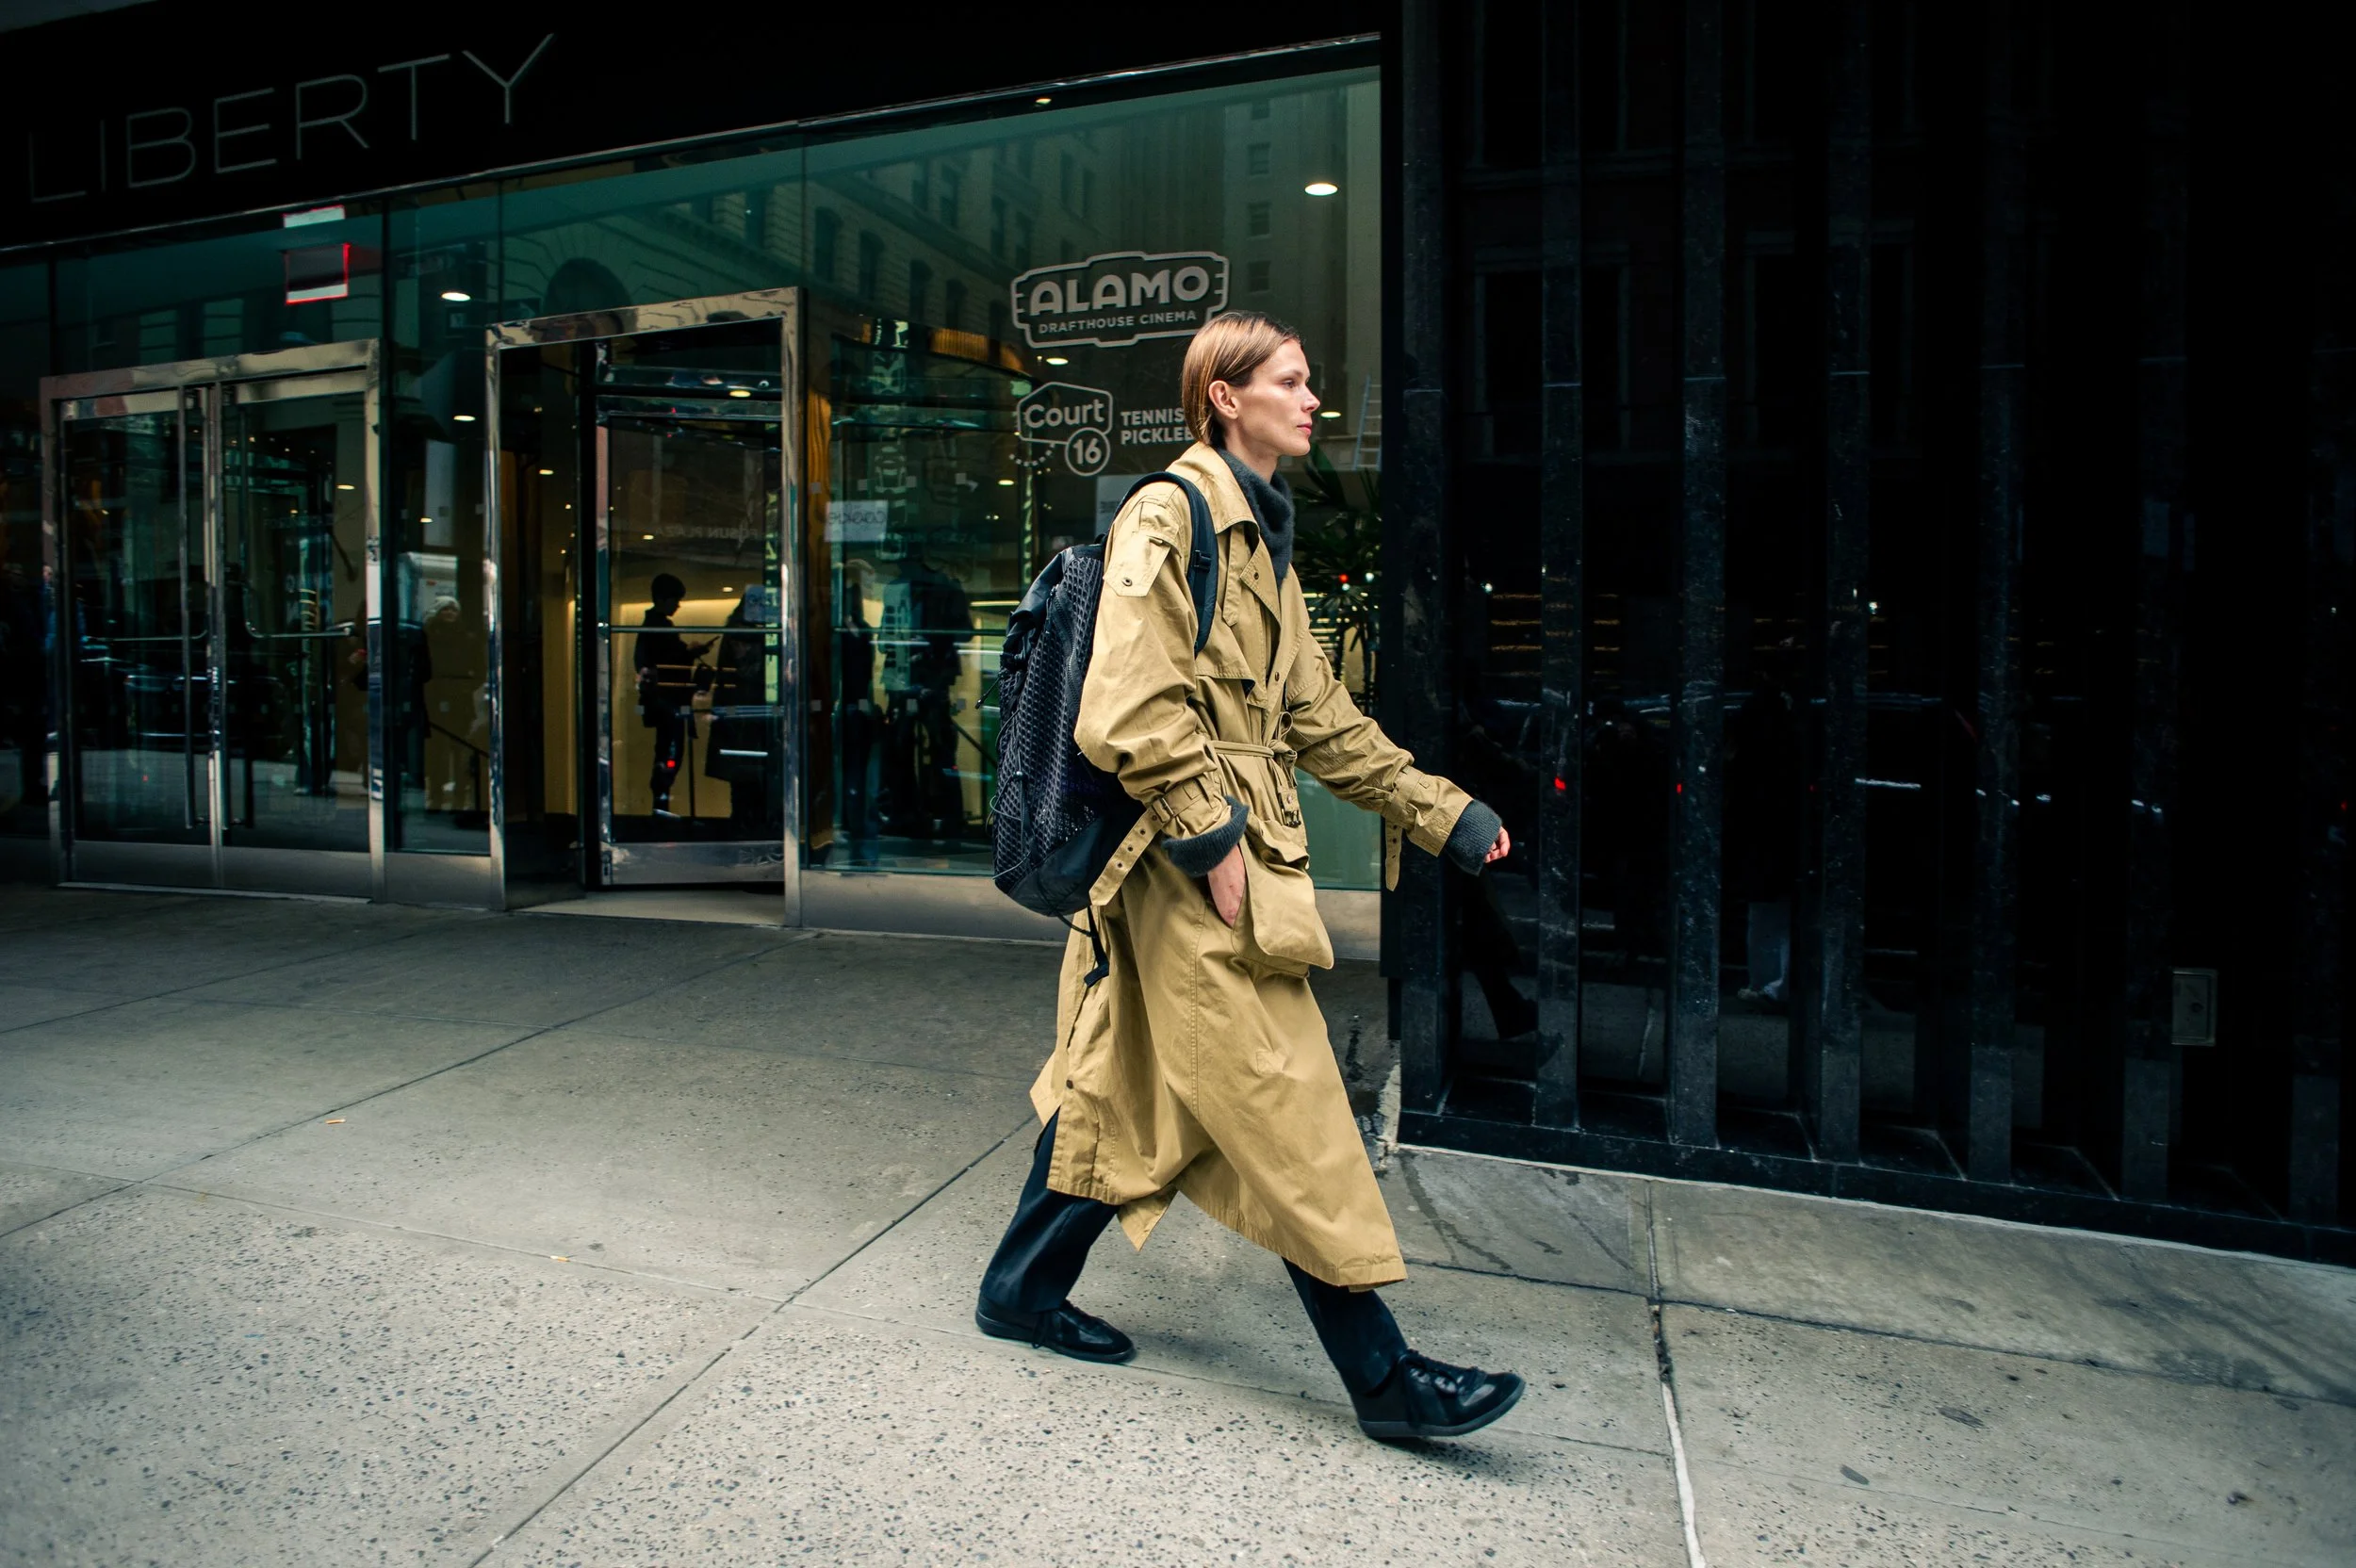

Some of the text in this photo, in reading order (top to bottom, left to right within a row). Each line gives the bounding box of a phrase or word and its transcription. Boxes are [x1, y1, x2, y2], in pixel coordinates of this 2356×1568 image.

[28, 33, 555, 204] LIBERTY
[1030, 266, 1209, 317] ALAMO
[1039, 310, 1197, 335] DRAFTHOUSE CINEMA
[1024, 399, 1105, 429] Court
[1120, 407, 1185, 426] TENNIS
[1072, 437, 1104, 465] 16
